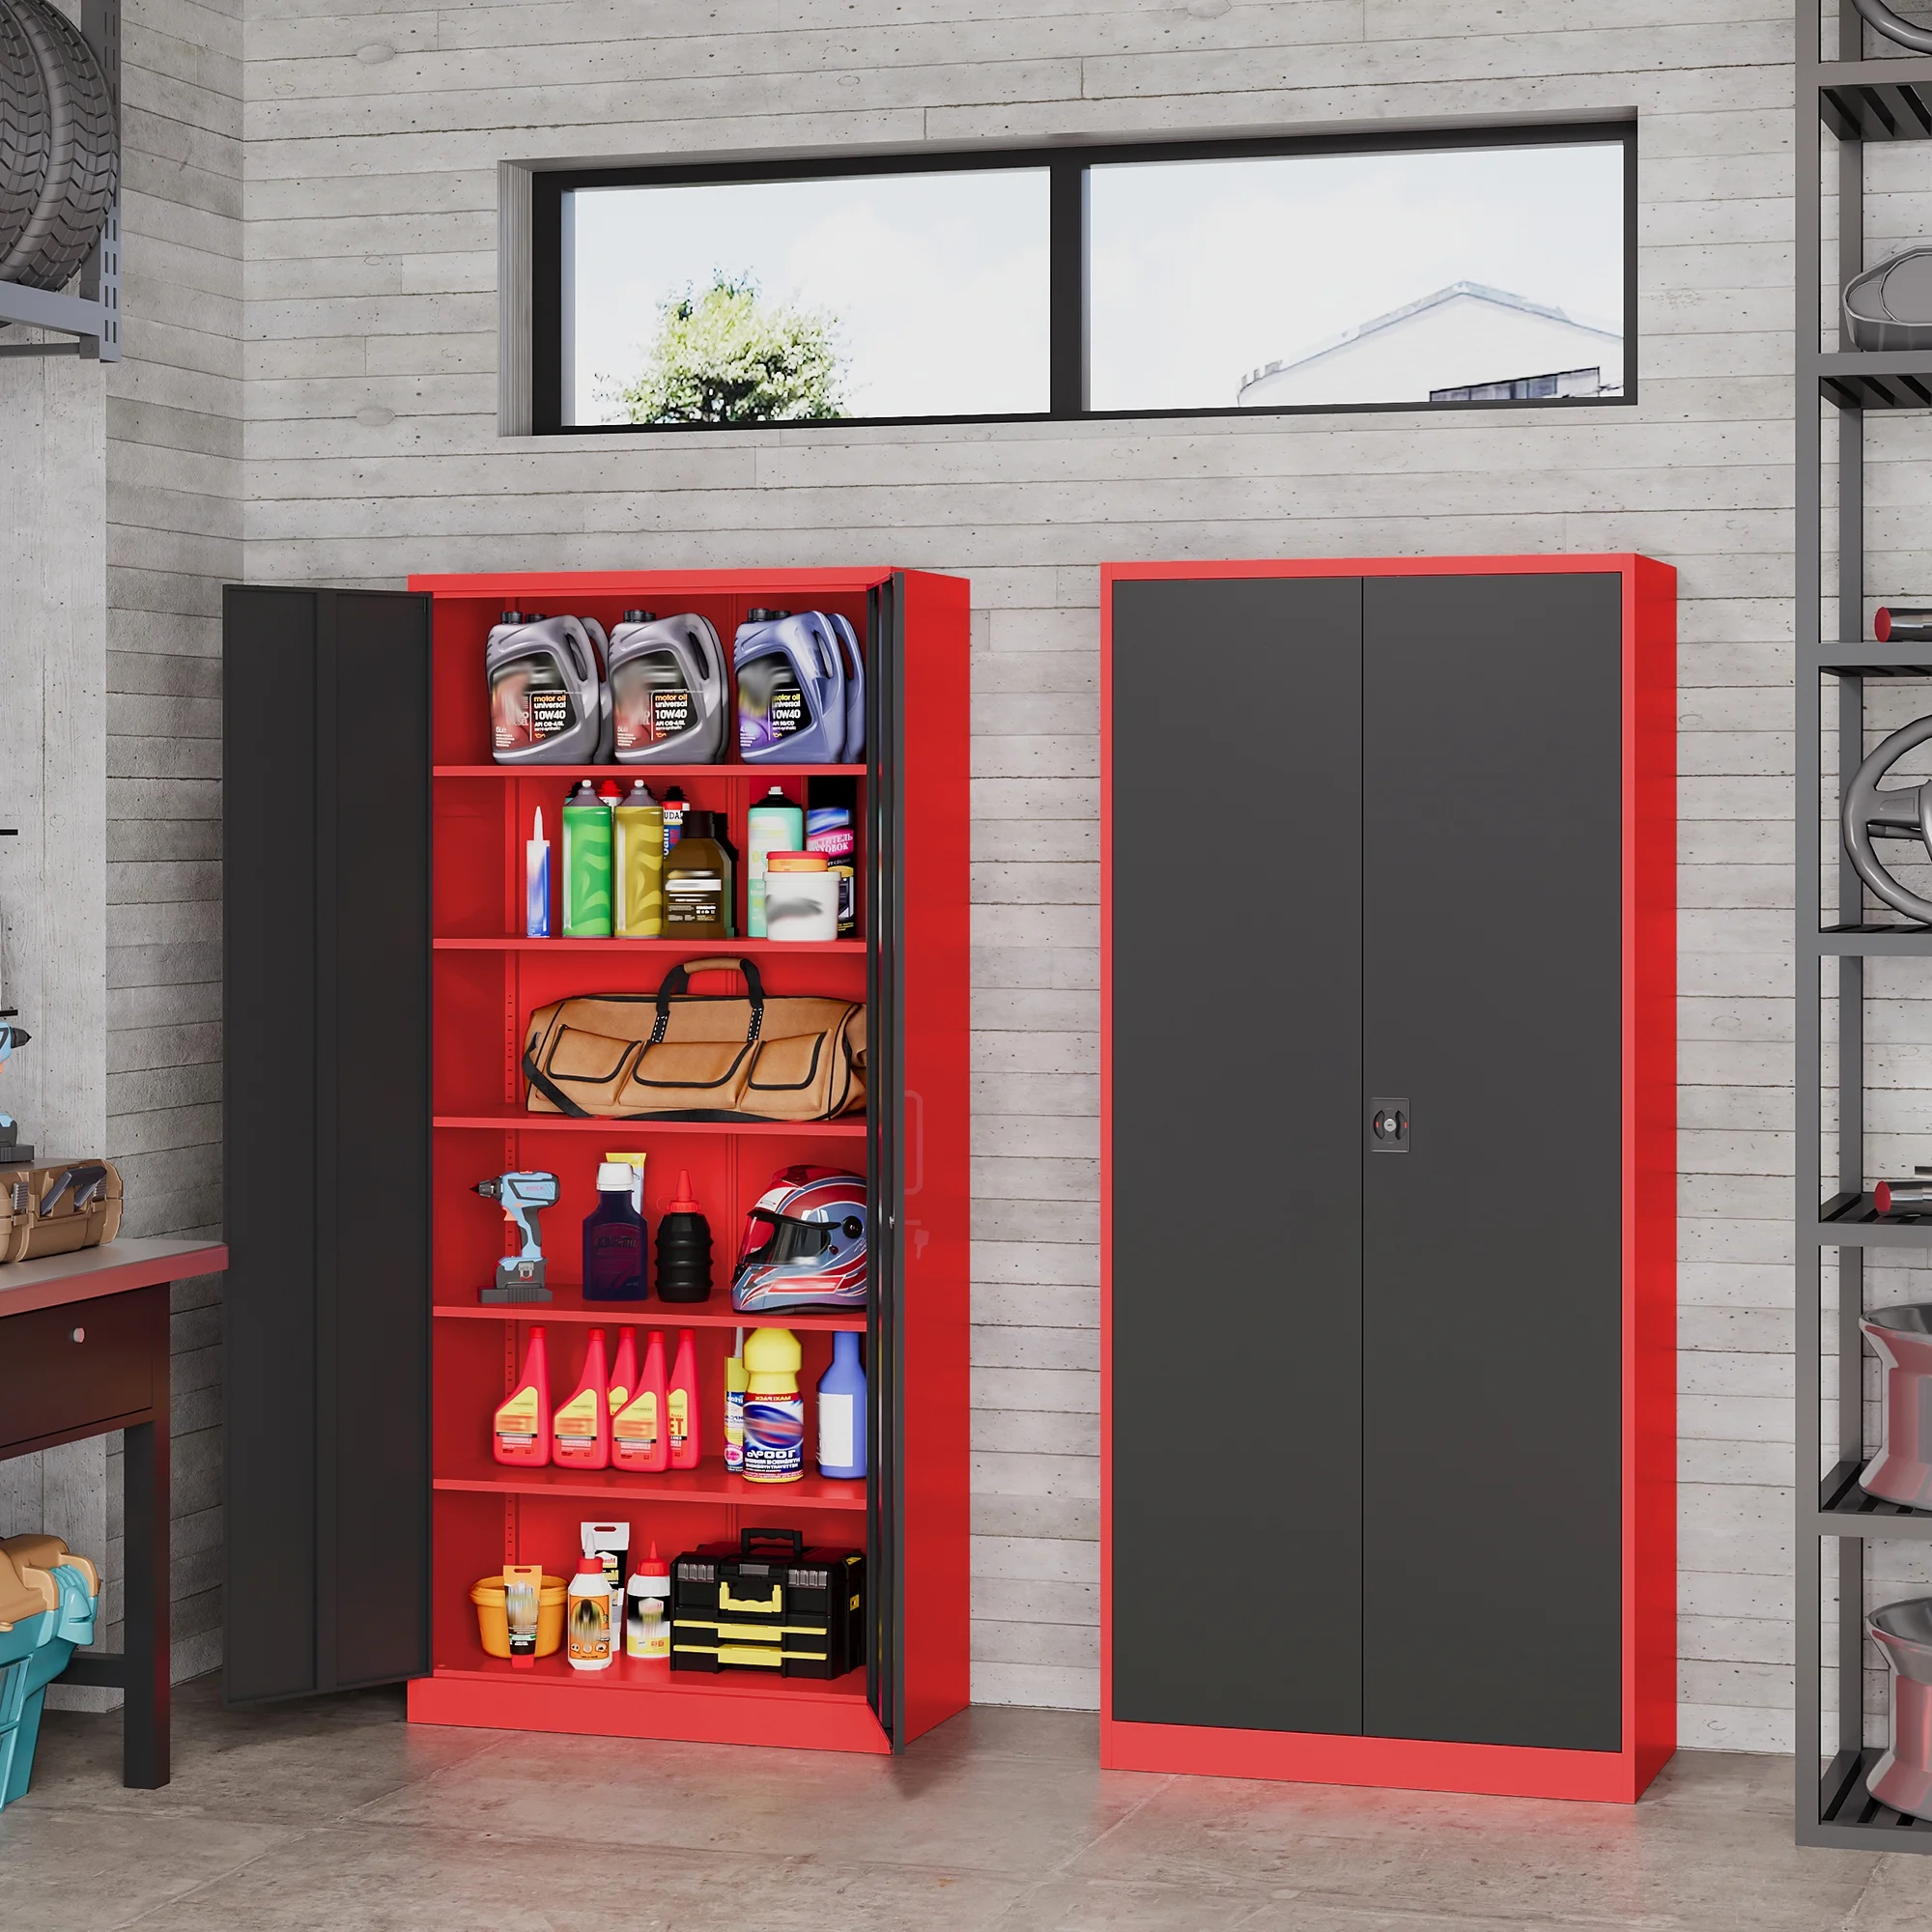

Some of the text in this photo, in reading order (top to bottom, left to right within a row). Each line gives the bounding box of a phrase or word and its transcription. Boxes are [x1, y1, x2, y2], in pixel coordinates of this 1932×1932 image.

[534, 710, 566, 720] 10W40
[655, 709, 688, 719] 10W40
[773, 709, 801, 719] 10W40
